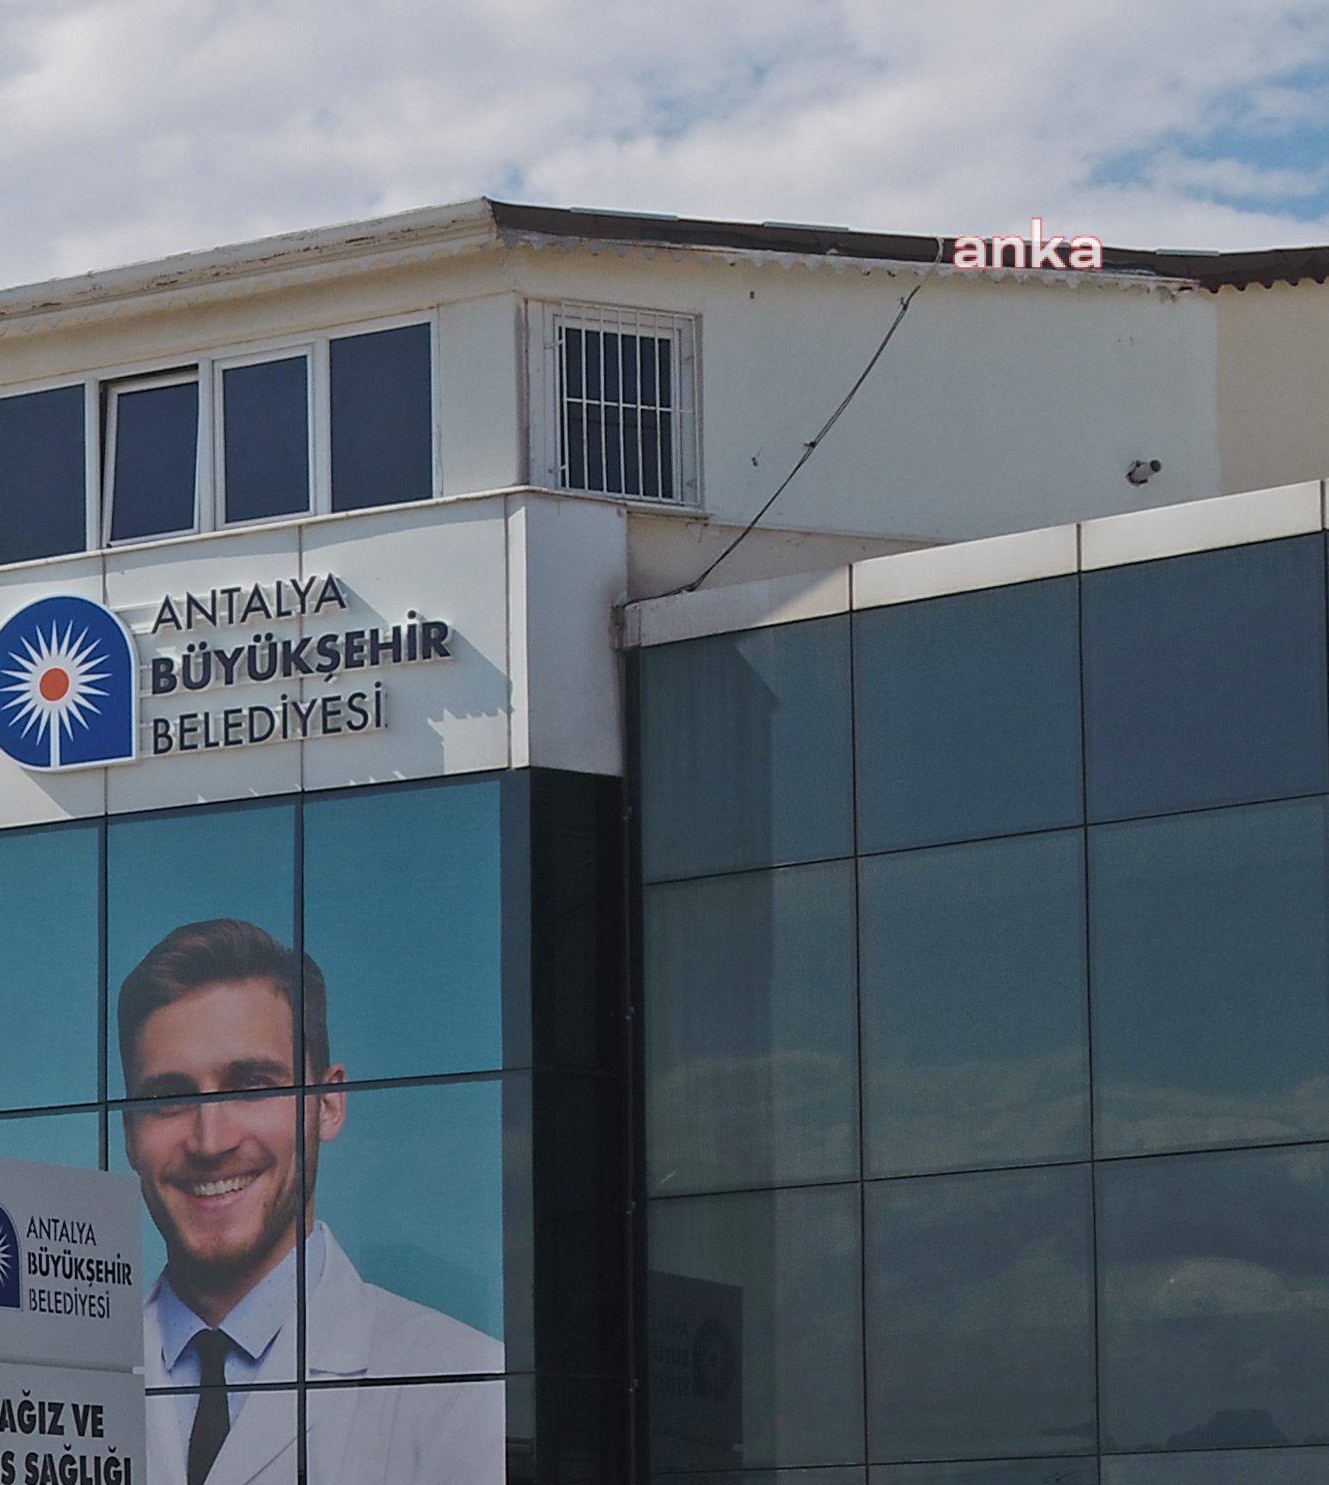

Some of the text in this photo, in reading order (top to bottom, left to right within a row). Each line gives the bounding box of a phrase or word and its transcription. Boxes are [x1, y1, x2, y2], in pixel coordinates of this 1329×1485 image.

[151, 572, 348, 635] ANTALYA
[151, 608, 452, 697] BÜYÜKŞEHİR
[153, 681, 385, 756] BELEDİYESİ
[26, 1215, 96, 1247] ANTALYA
[27, 1246, 133, 1288] BÜYÜKŞEHİR
[29, 1286, 110, 1319] BELEDİYESİ
[71, 1403, 104, 1438] VE
